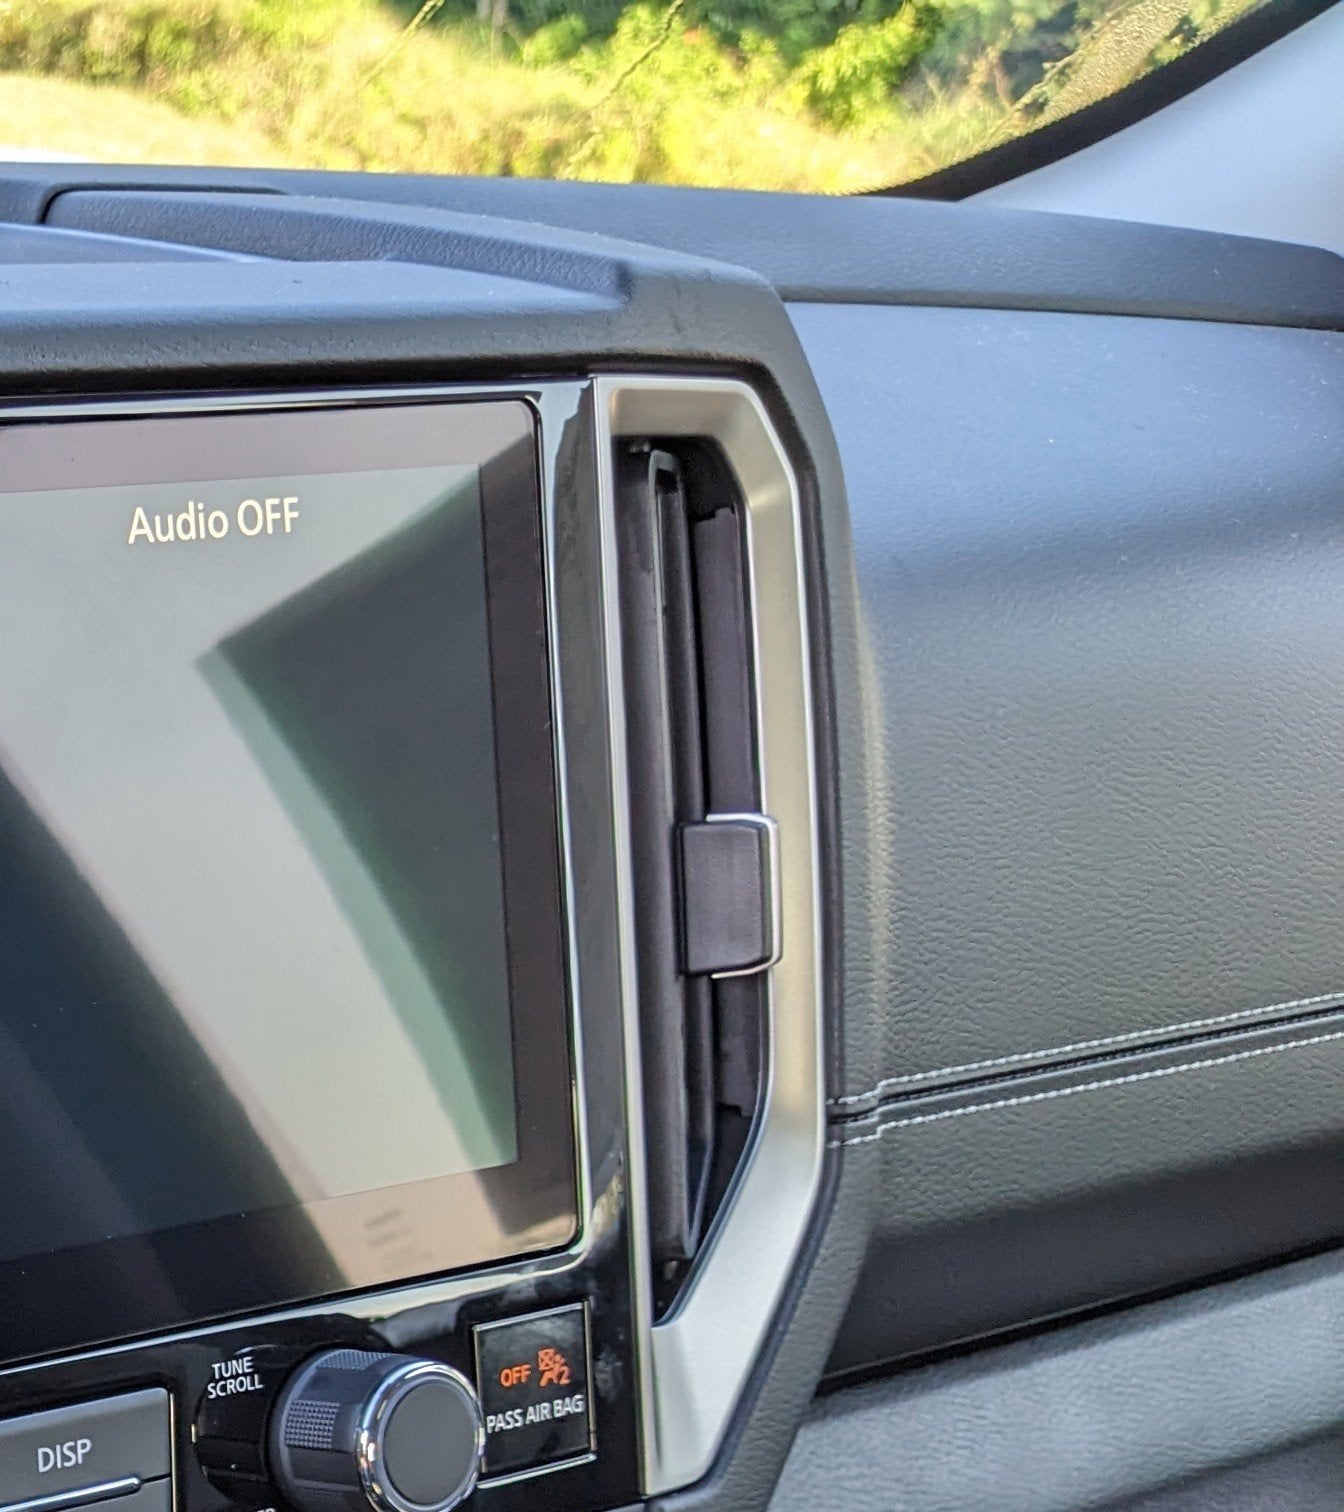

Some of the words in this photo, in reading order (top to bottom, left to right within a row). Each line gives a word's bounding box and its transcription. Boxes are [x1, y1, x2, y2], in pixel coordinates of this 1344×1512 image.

[127, 505, 229, 545] Audio
[236, 496, 300, 535] OFF
[212, 1356, 255, 1380] TUNE
[499, 1364, 531, 1388] OFF
[207, 1374, 264, 1400] SCROLL
[486, 1408, 524, 1434] PASS
[525, 1402, 553, 1424] AIR
[552, 1394, 585, 1418] BAG
[37, 1438, 93, 1473] DISP
